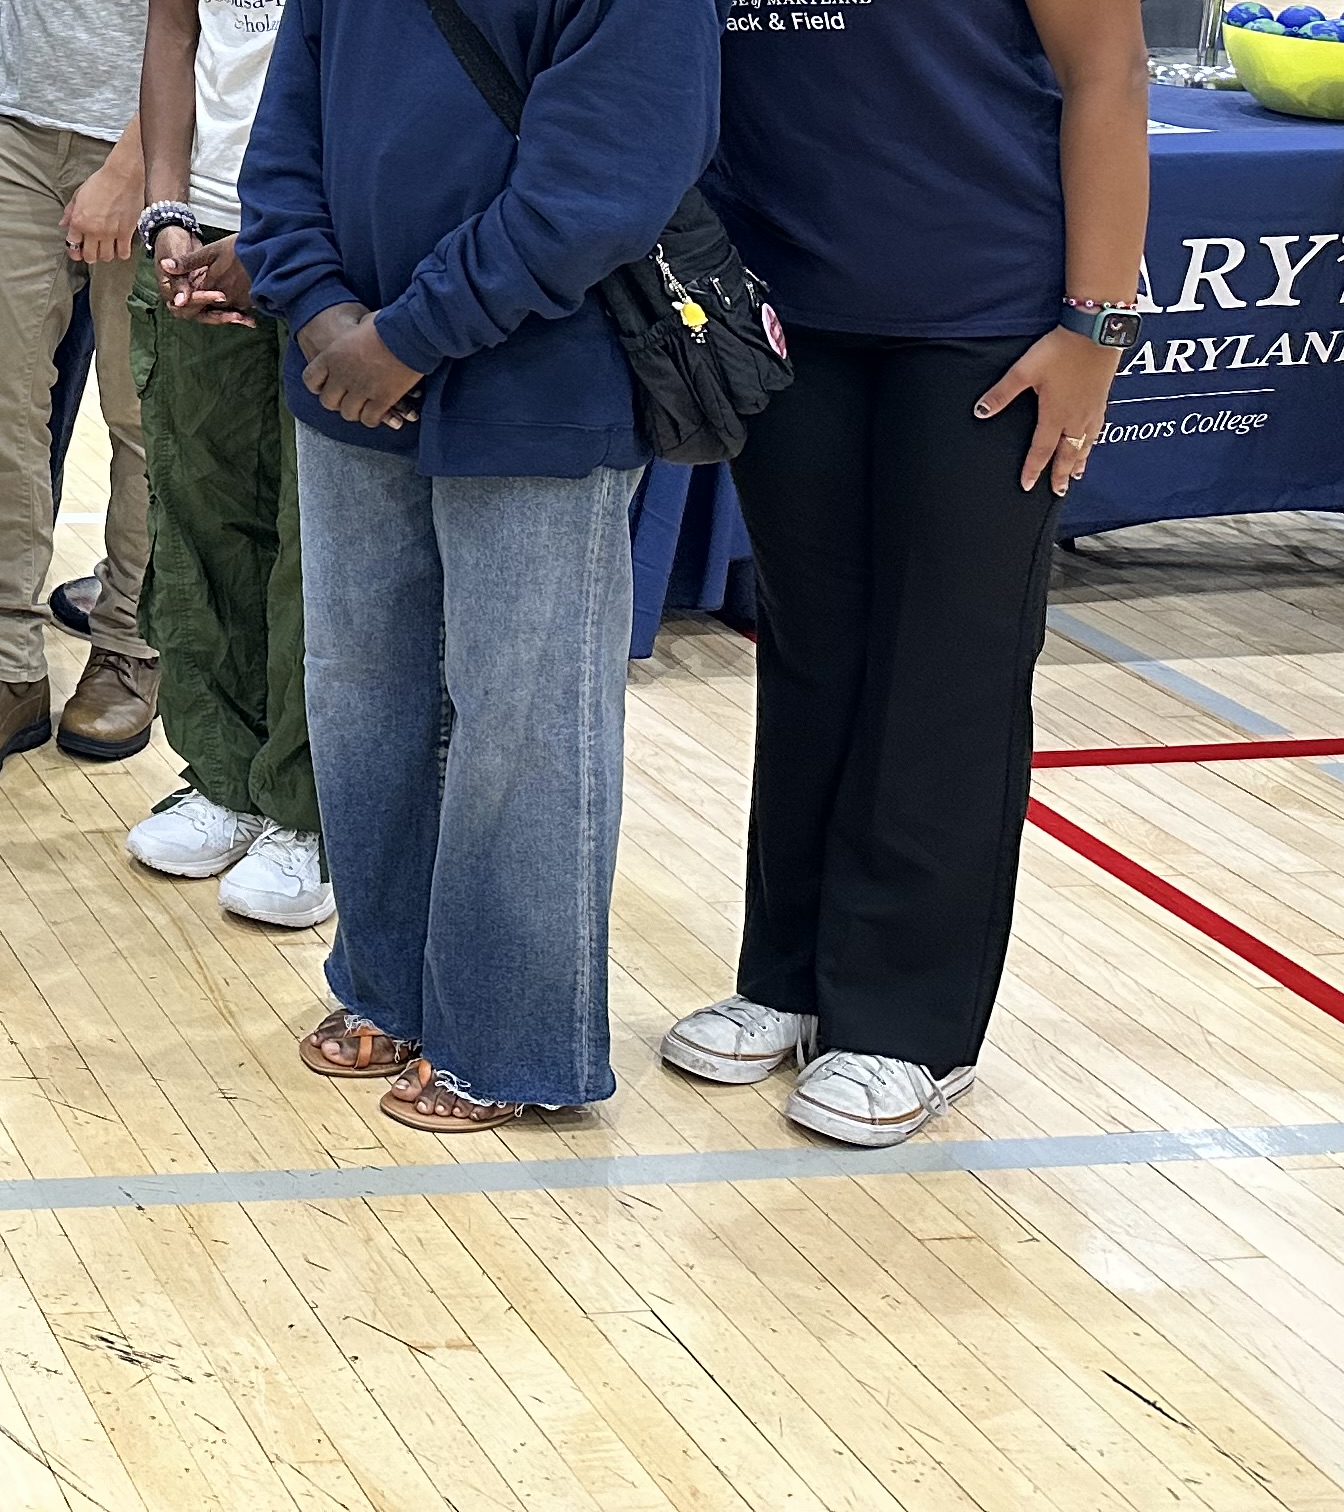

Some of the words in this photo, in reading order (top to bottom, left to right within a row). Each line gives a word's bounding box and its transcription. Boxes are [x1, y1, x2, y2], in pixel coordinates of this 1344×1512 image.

[727, 14, 763, 31] ack
[769, 12, 786, 31] &
[791, 12, 845, 30] Field
[1115, 330, 1344, 376] ARYLAN
[1181, 410, 1268, 435] College
